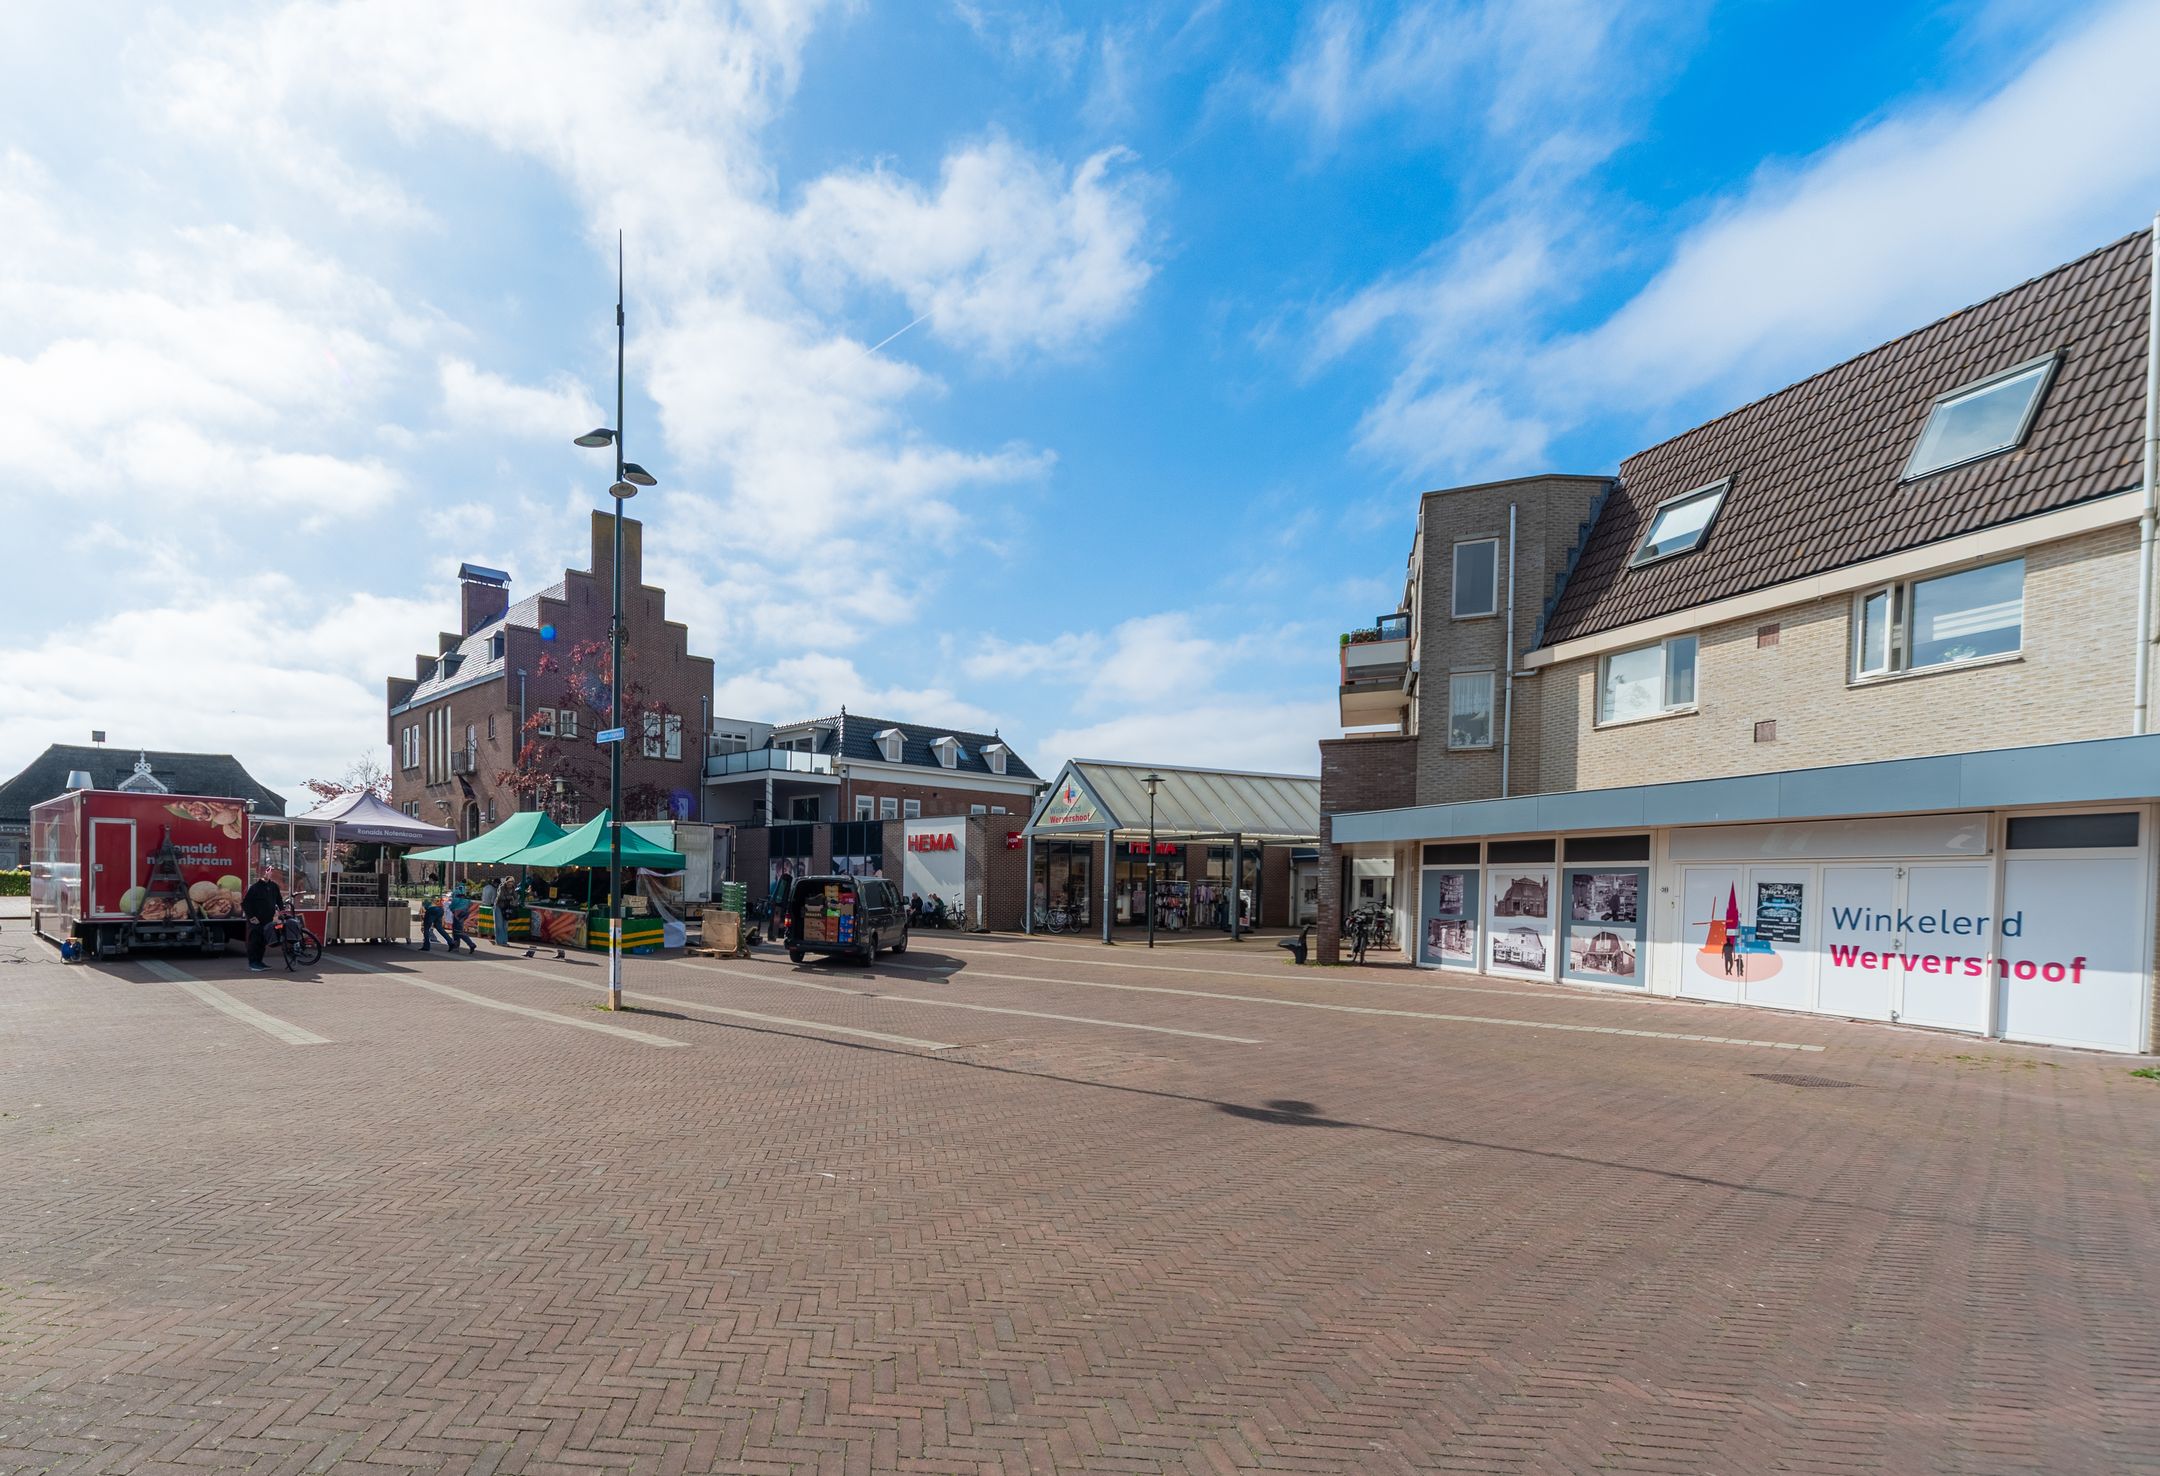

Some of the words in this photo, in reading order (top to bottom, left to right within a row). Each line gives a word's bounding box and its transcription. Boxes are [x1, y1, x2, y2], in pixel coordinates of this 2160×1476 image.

[1050, 805, 1081, 814] Winkend
[357, 828, 383, 836] Ronalds
[384, 830, 423, 838] Notenkraam
[908, 833, 956, 852] HEMA
[173, 843, 217, 854] onalds
[146, 855, 233, 866] nonkraam
